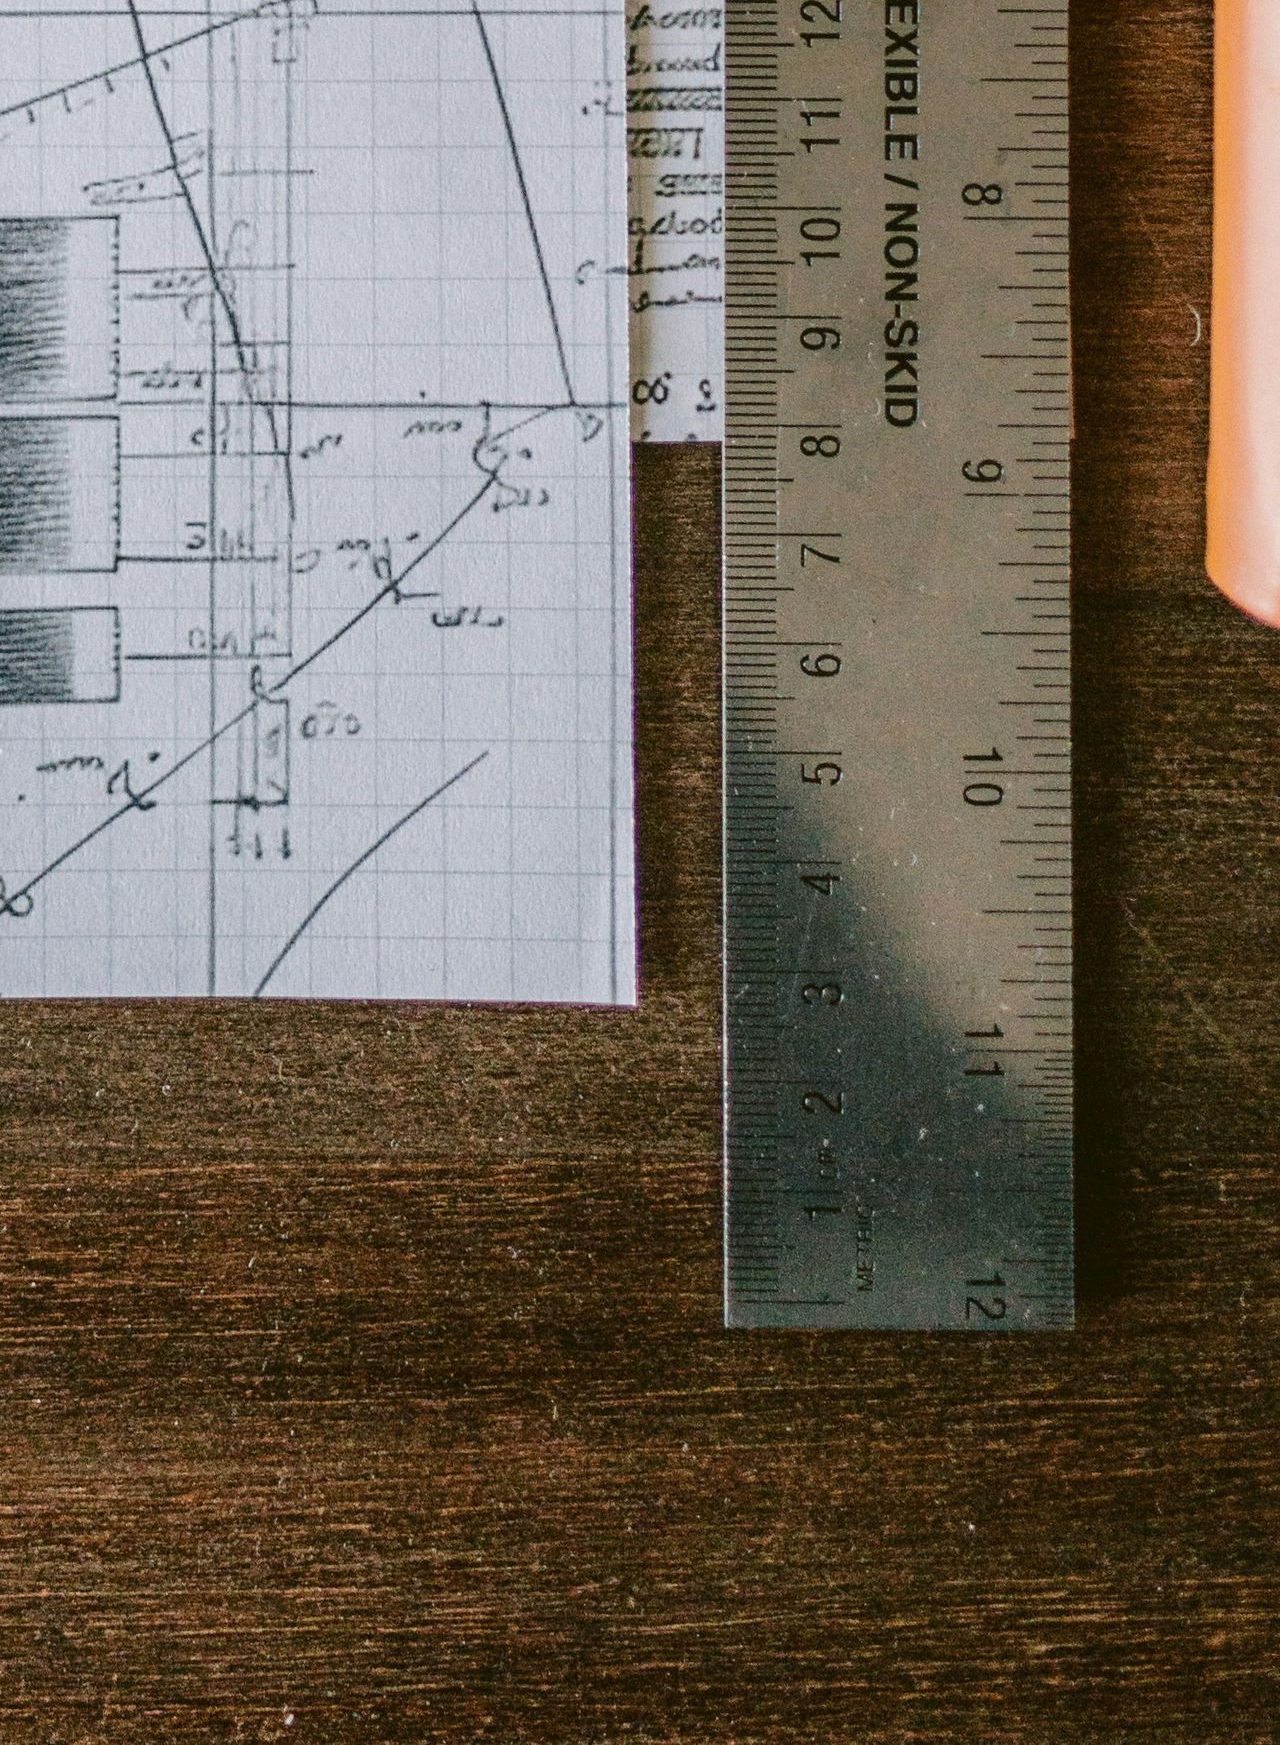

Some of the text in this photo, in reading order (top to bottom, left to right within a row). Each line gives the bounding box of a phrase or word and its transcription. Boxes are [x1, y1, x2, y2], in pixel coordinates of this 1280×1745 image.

[799, 110, 840, 154] 11
[883, 172, 920, 191] /
[961, 182, 1003, 207] 8
[799, 217, 841, 268] 10
[883, 201, 920, 429] NON-SKID
[799, 326, 841, 352] 9
[799, 434, 841, 459] 8
[961, 458, 1004, 484] 9
[799, 543, 841, 568] 7
[799, 653, 841, 678] 6
[799, 761, 842, 786] 5
[962, 746, 1004, 808] 10
[799, 872, 840, 897] 4
[799, 981, 842, 1007] 3
[963, 1023, 1005, 1077] 11
[799, 1090, 842, 1114] 2
[855, 1205, 875, 1293] METRIC
[965, 1270, 1007, 1320] 12
